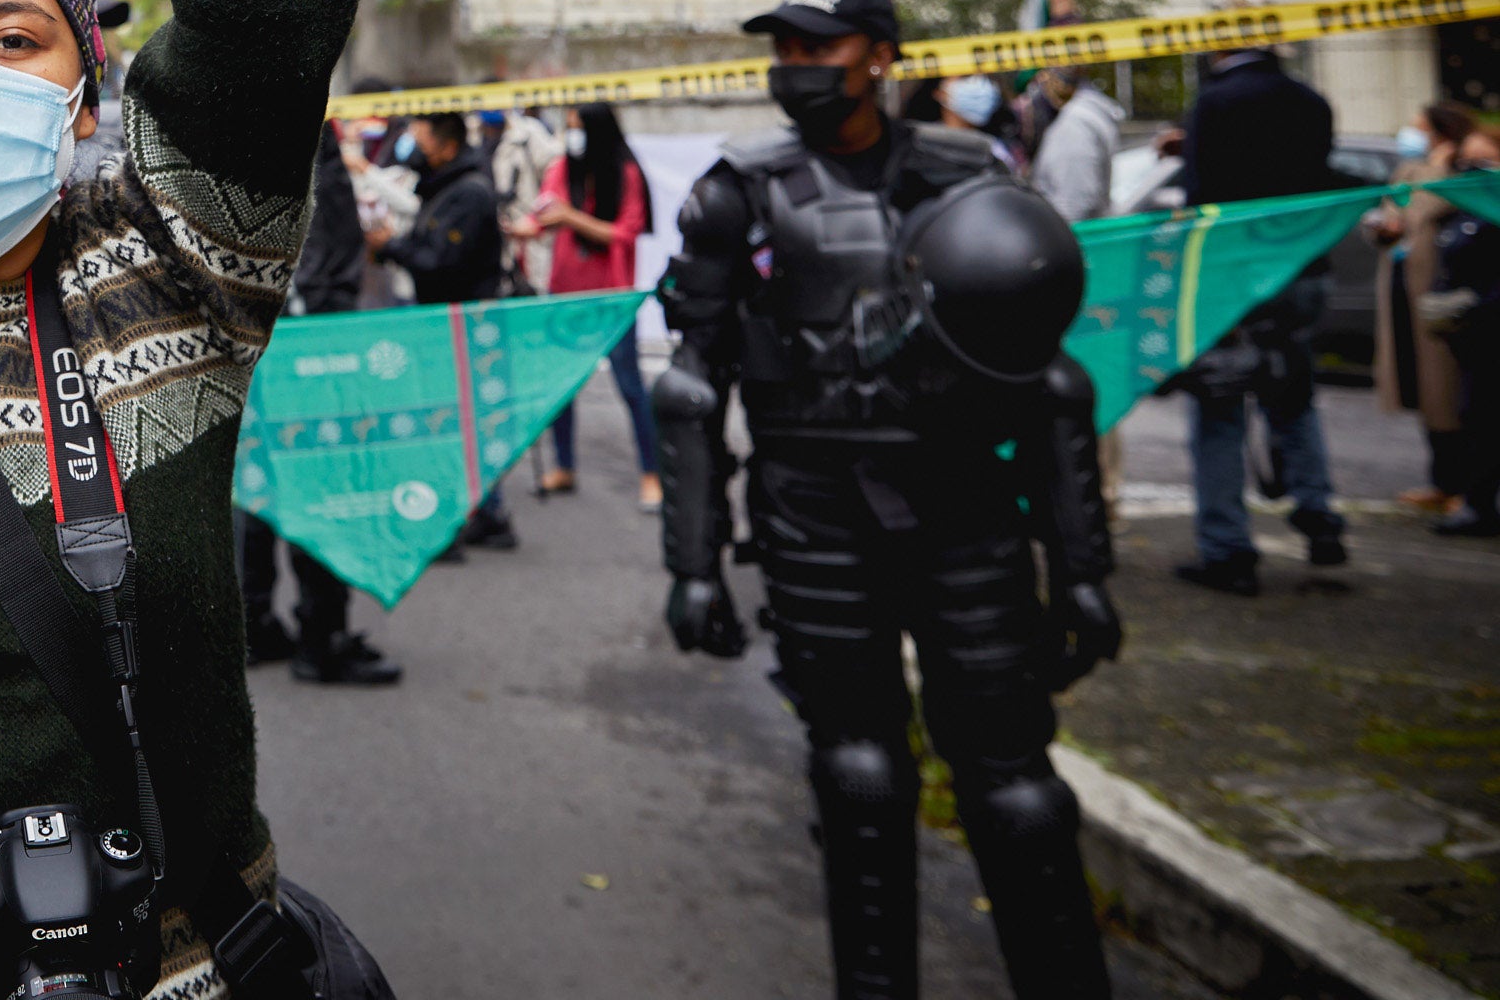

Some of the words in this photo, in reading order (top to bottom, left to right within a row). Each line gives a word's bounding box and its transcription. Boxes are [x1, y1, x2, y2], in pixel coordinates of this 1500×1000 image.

[1138, 12, 1283, 57] PELIGRO
[51, 347, 91, 428] EOS
[64, 436, 99, 482] 7D
[31, 923, 88, 941] Canon
